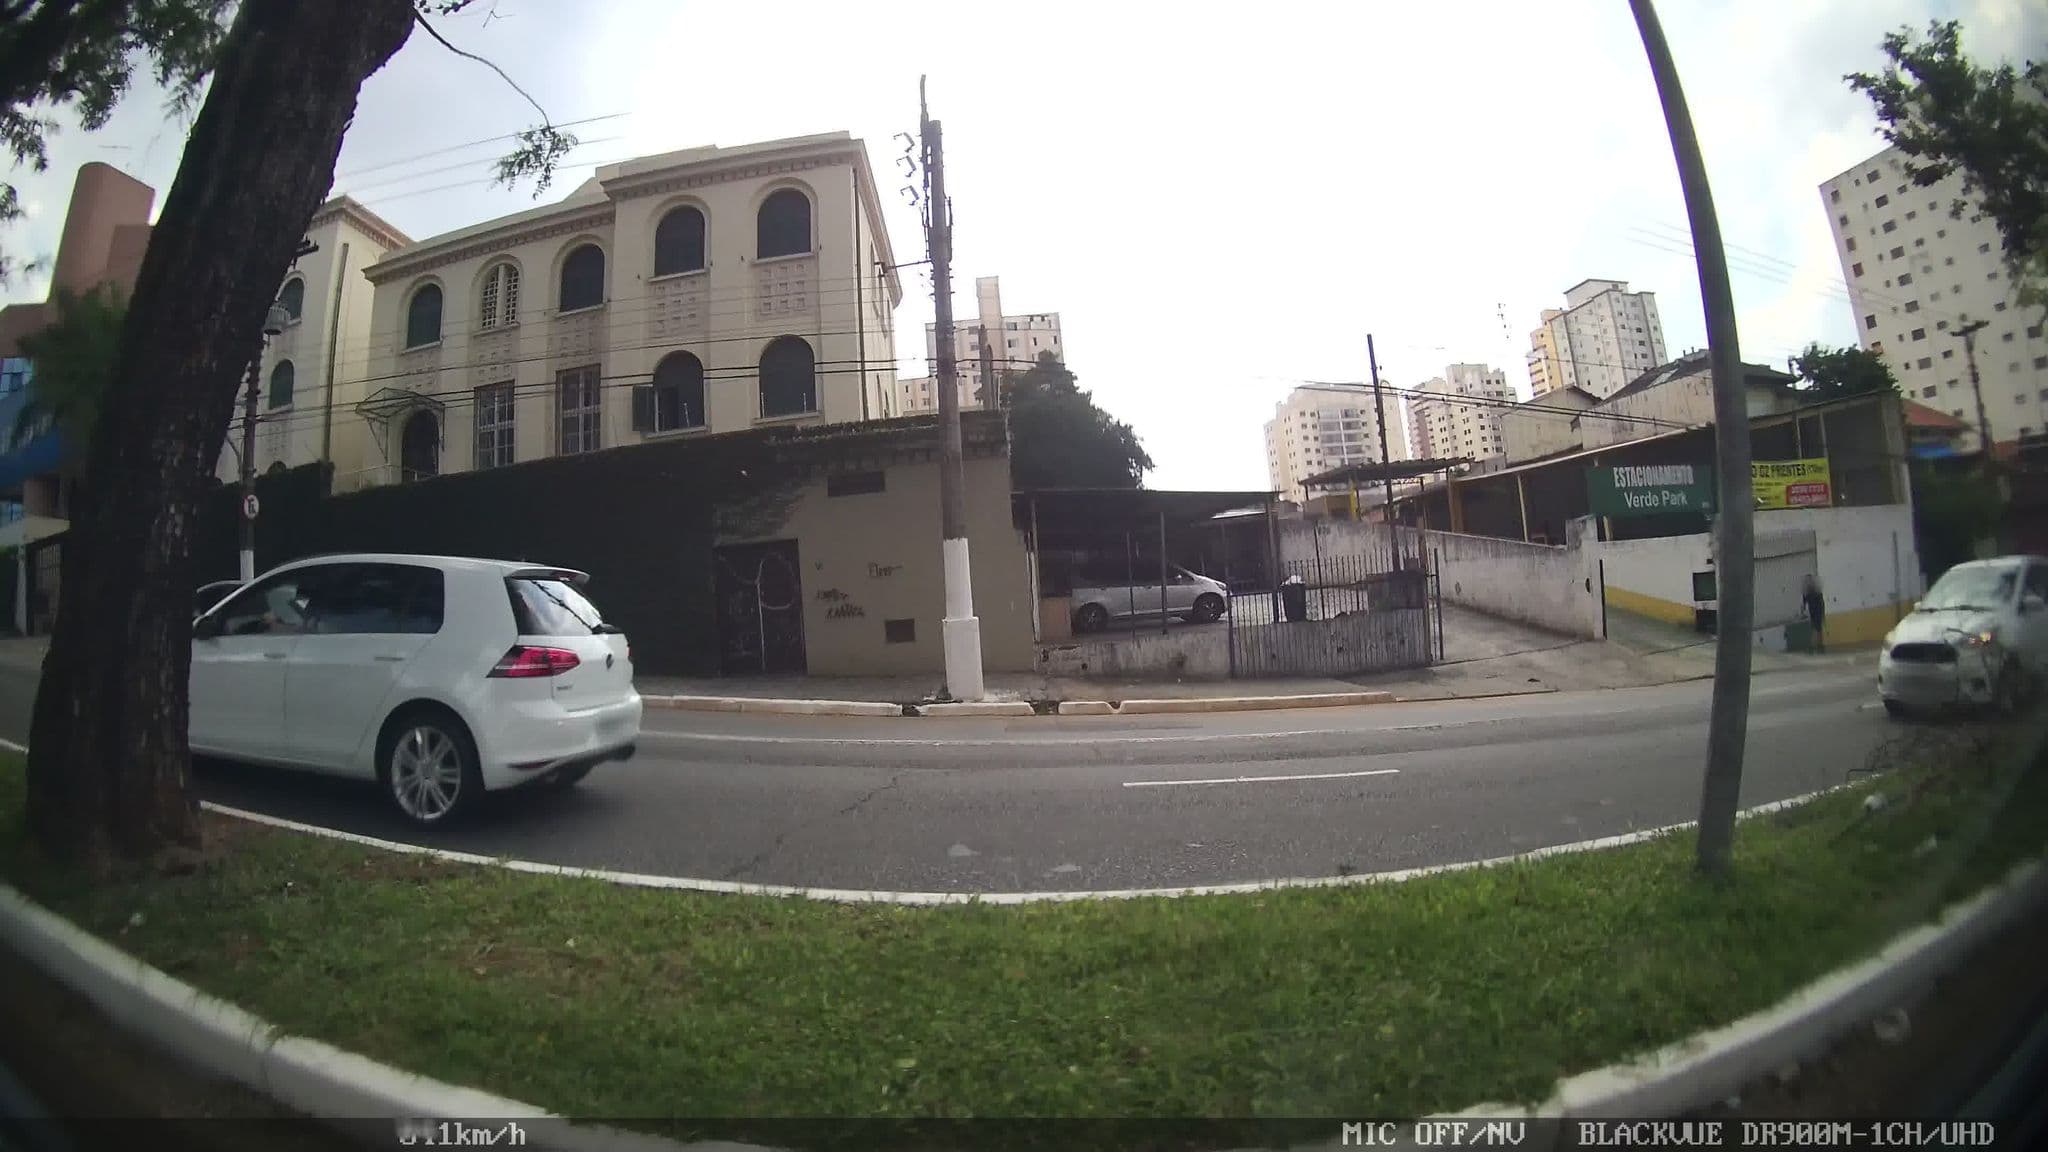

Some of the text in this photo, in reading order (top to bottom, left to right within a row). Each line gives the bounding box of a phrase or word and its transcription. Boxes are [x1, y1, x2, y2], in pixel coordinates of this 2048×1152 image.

[1613, 465, 1694, 487] ESTACIONAMENTO
[1624, 491, 1659, 508] Verde
[1661, 490, 1688, 506] Park
